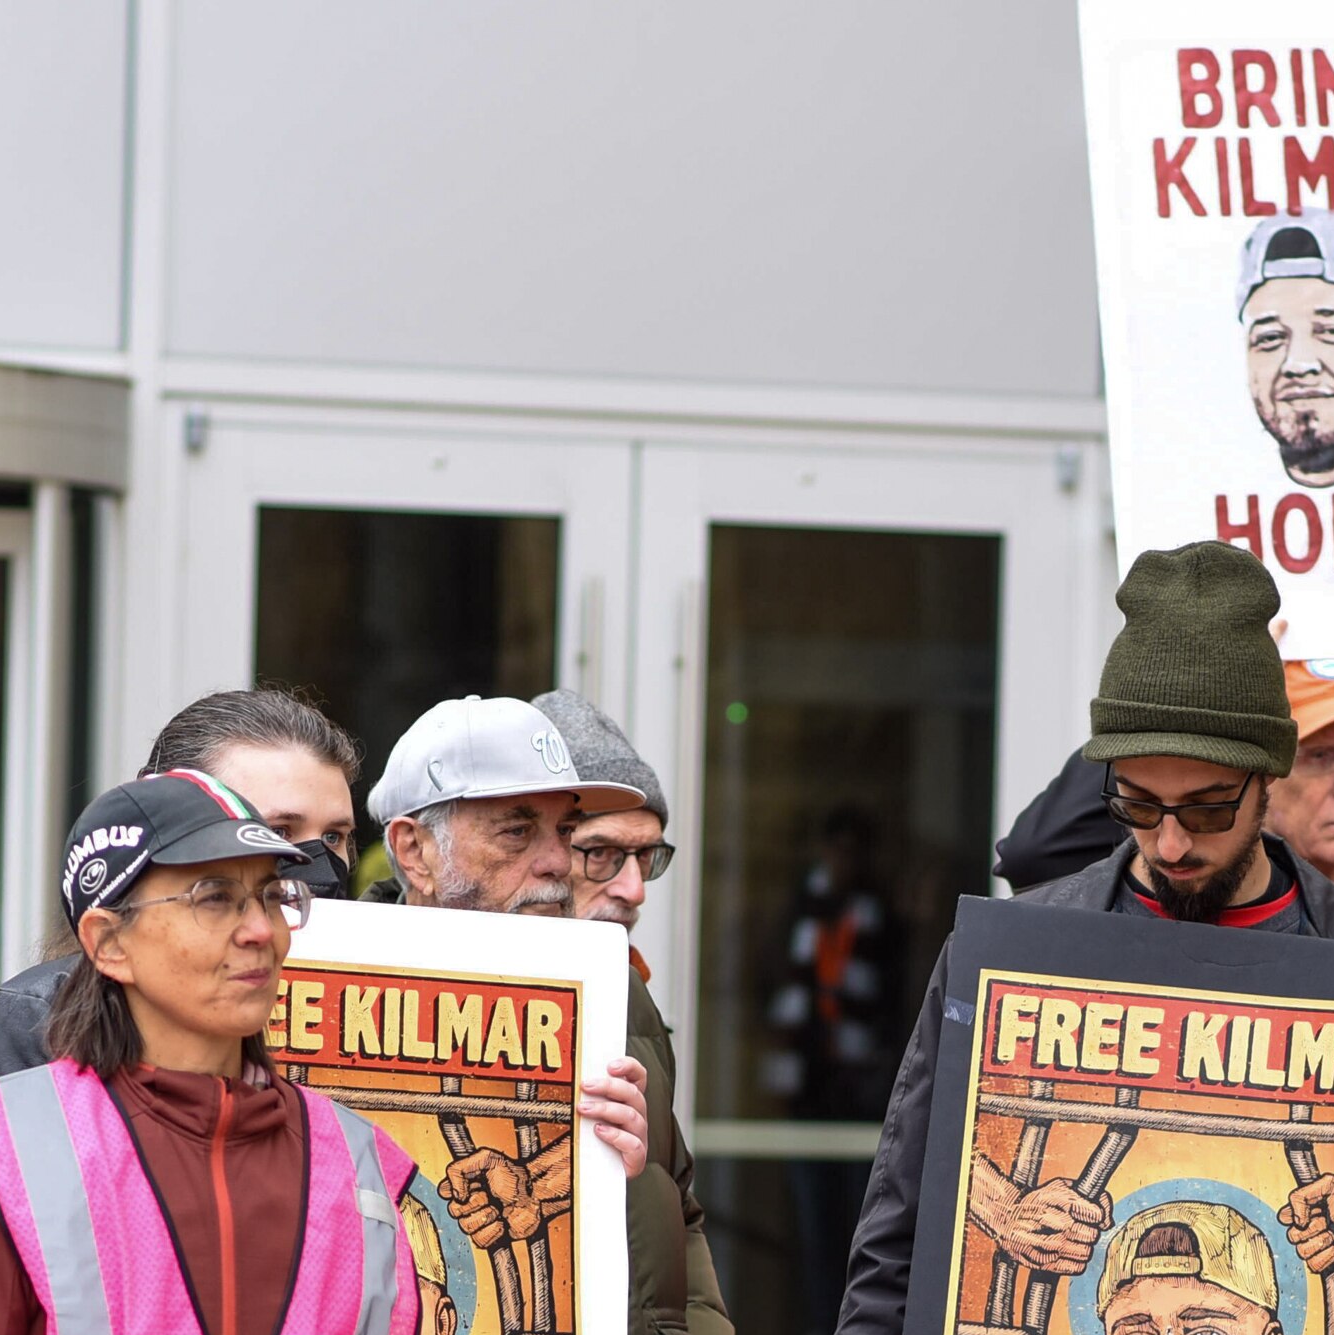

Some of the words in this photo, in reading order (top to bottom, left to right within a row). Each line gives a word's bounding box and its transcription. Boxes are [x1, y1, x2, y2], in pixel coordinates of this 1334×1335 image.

[62, 825, 144, 917] OLUMBUS
[343, 984, 564, 1069] KILMAR
[996, 993, 1166, 1075] FREE
